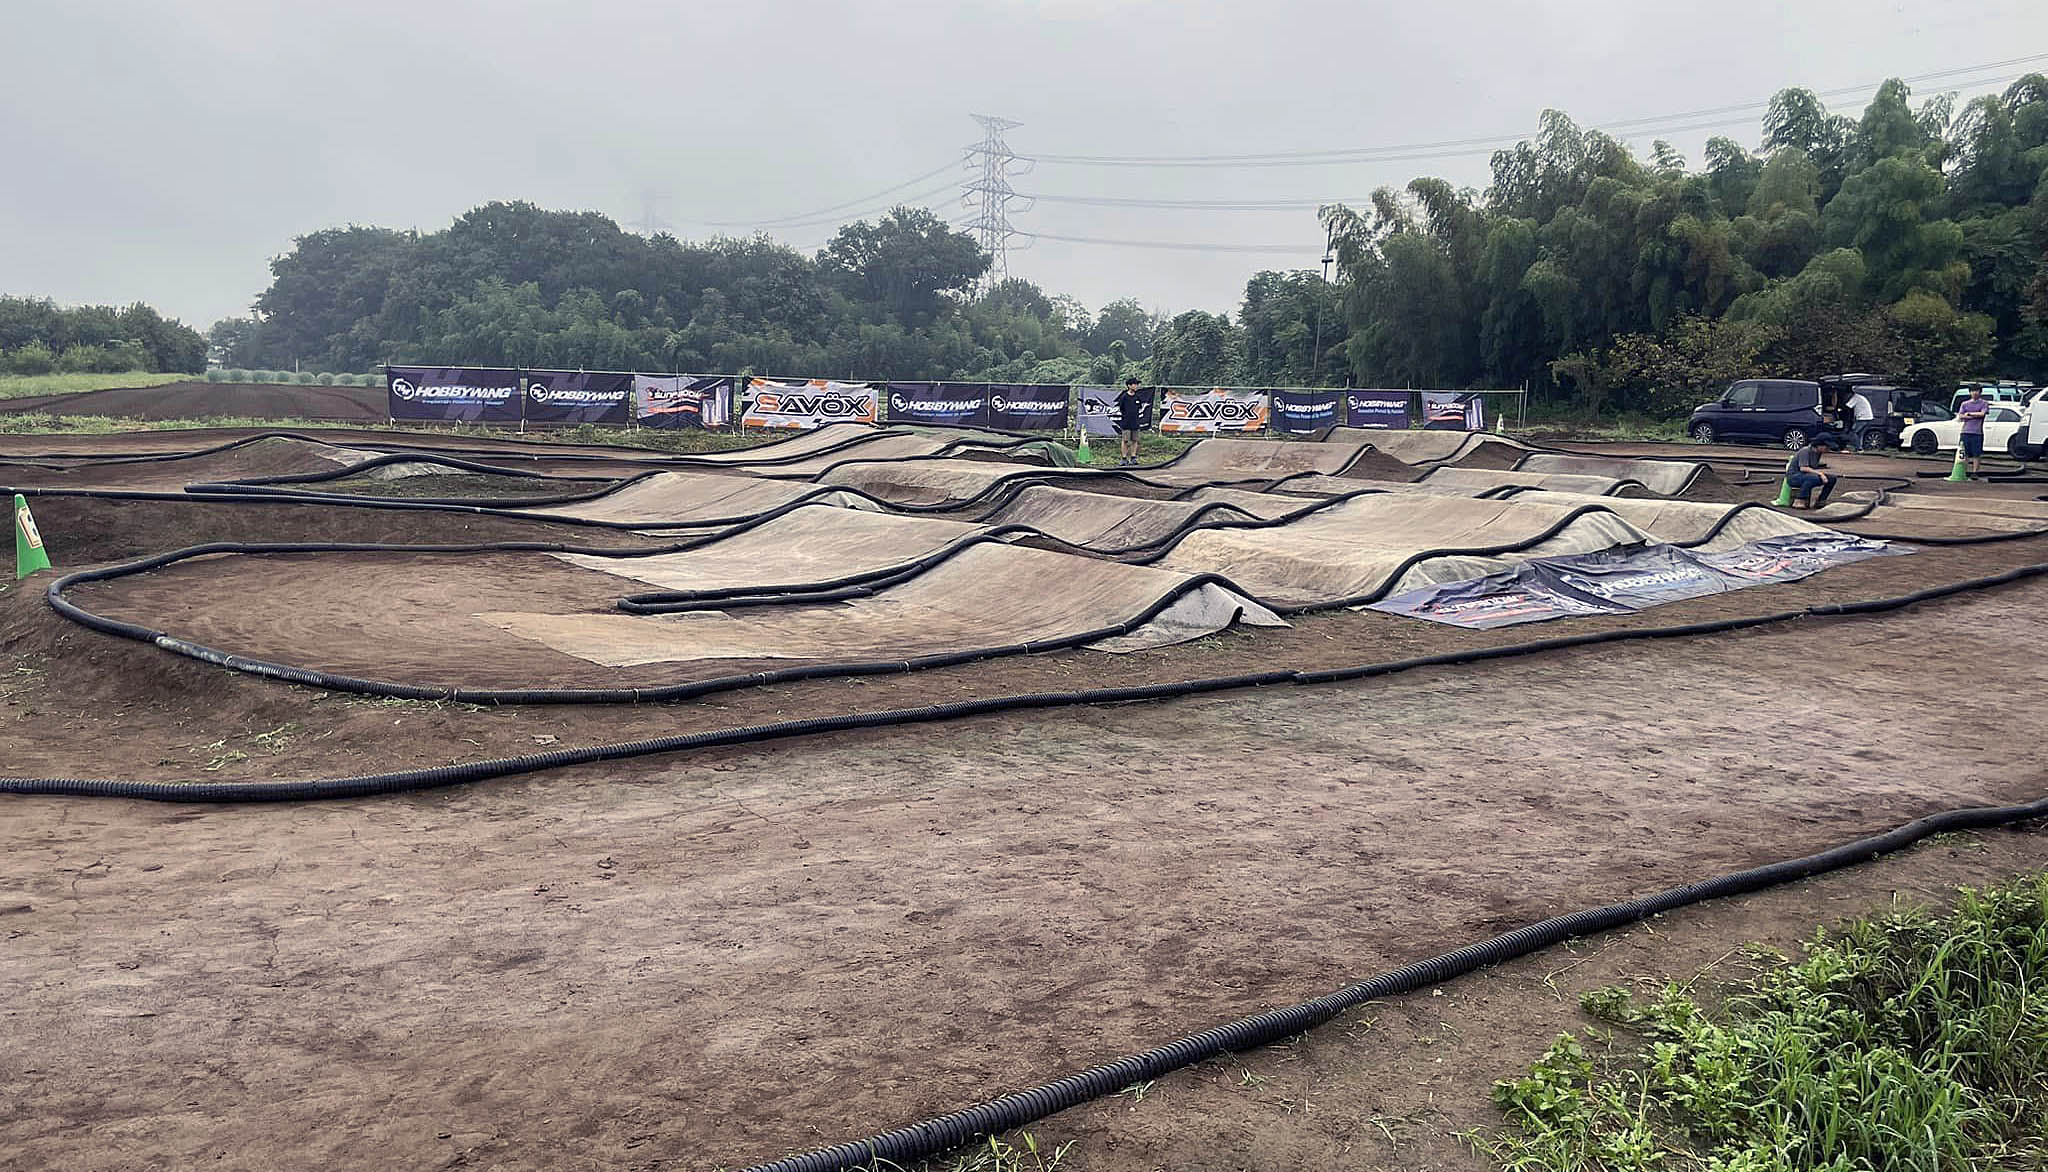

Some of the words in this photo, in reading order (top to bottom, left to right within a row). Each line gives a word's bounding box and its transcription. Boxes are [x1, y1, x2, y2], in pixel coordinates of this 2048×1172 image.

[415, 386, 512, 398] HOBBYWING
[548, 390, 625, 401] HOBBYWING
[755, 392, 869, 417] SAVÖX
[908, 400, 981, 412] HOBBYWING
[1169, 399, 1259, 420] SAVÖX
